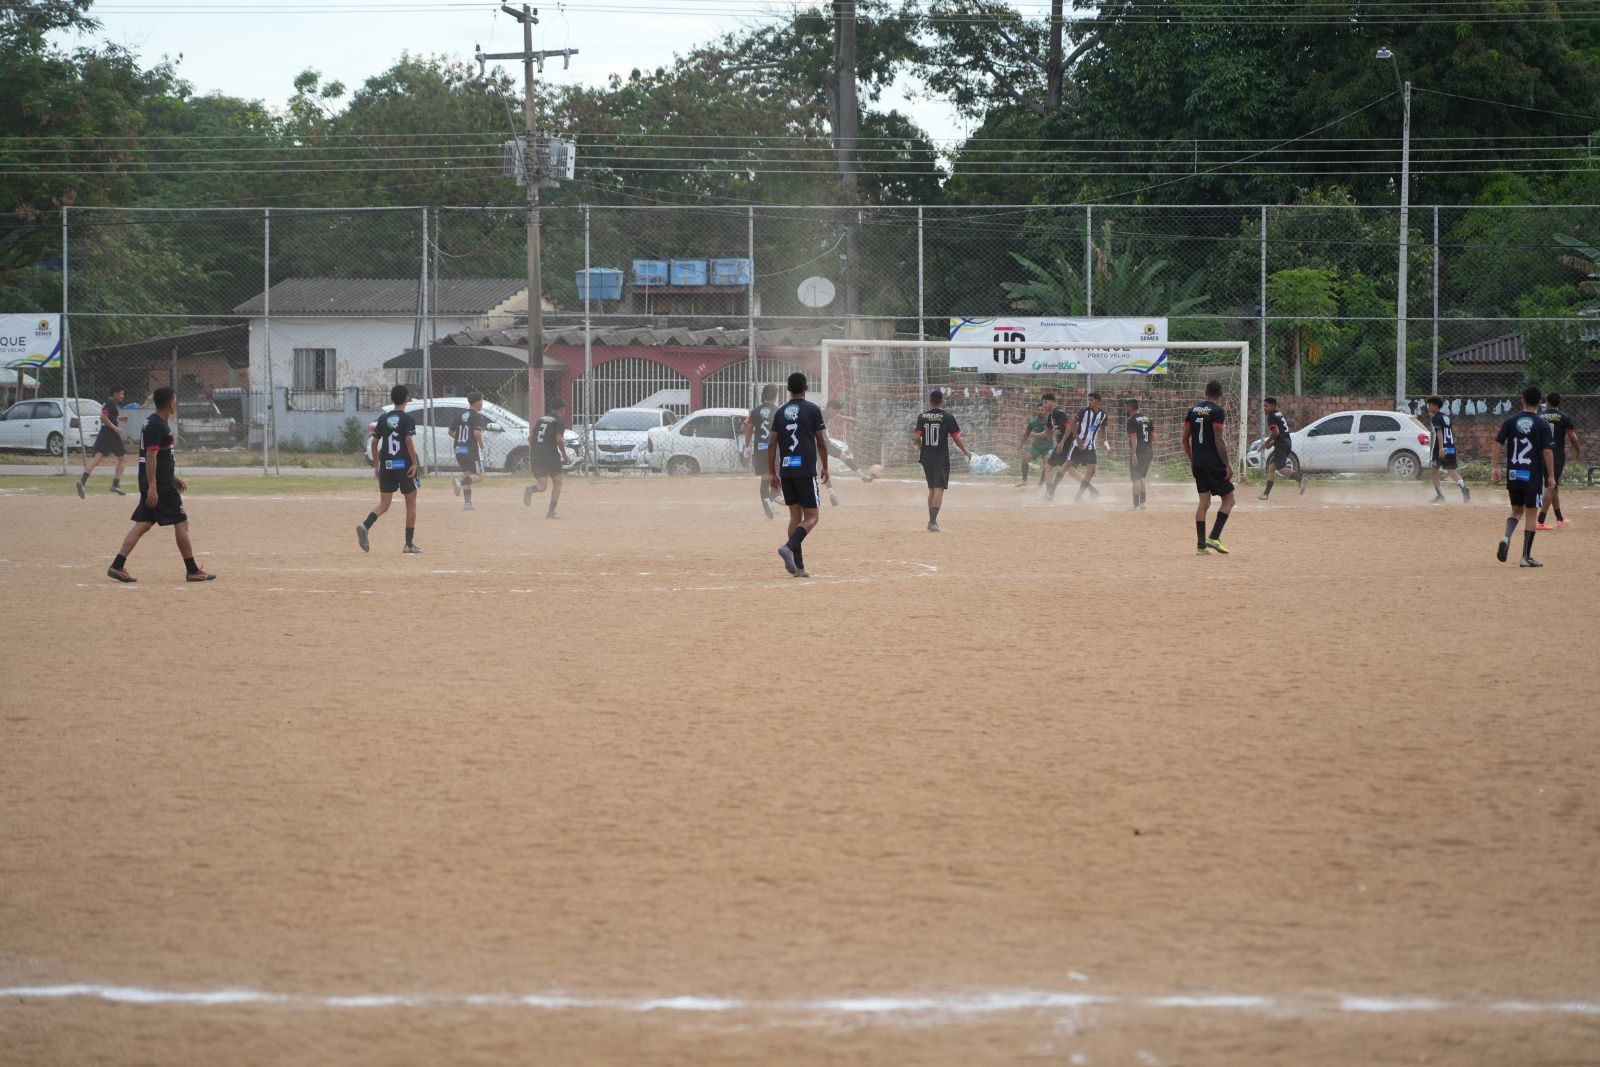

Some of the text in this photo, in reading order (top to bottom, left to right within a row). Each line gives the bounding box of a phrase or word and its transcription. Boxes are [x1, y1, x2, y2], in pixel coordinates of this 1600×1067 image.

[458, 424, 469, 443] 10
[760, 419, 770, 439] 5
[785, 422, 799, 452] 3
[923, 423, 940, 446] 10
[1443, 426, 1454, 445] 14
[388, 431, 401, 456] 6
[1510, 436, 1533, 465] 12
